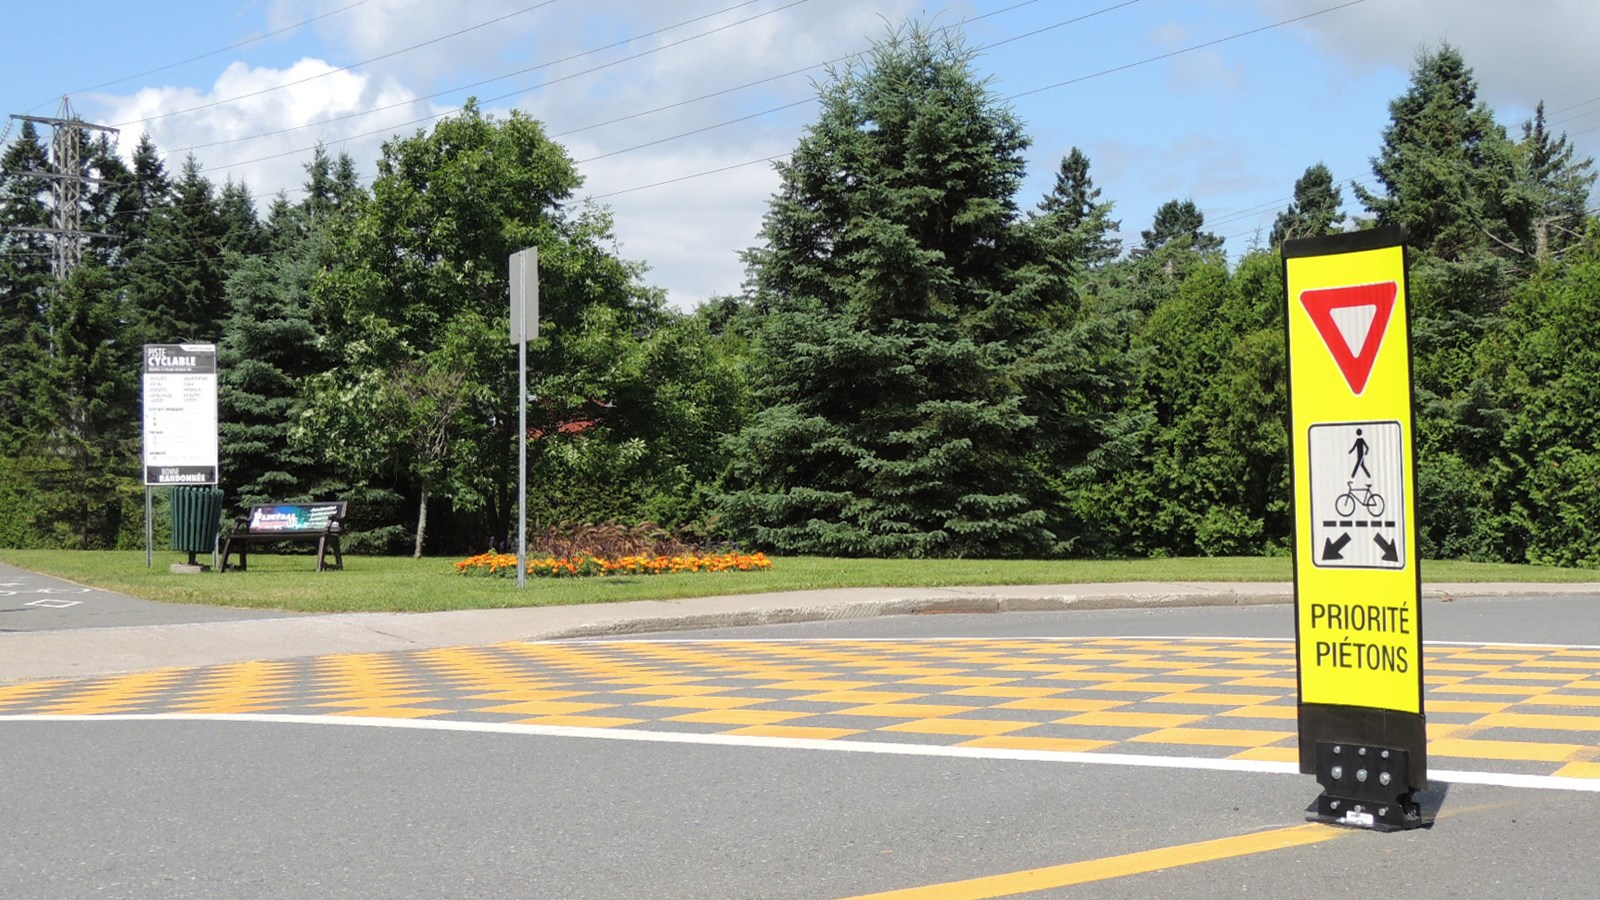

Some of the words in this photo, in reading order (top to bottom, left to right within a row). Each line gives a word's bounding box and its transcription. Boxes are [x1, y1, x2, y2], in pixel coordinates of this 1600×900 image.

[147, 347, 166, 357] PISTE
[147, 356, 197, 366] CYCLABLE
[158, 472, 206, 482] RANDONNÉE
[1311, 601, 1410, 635] PRIORITÉ
[1316, 635, 1409, 674] PIÉTONS
